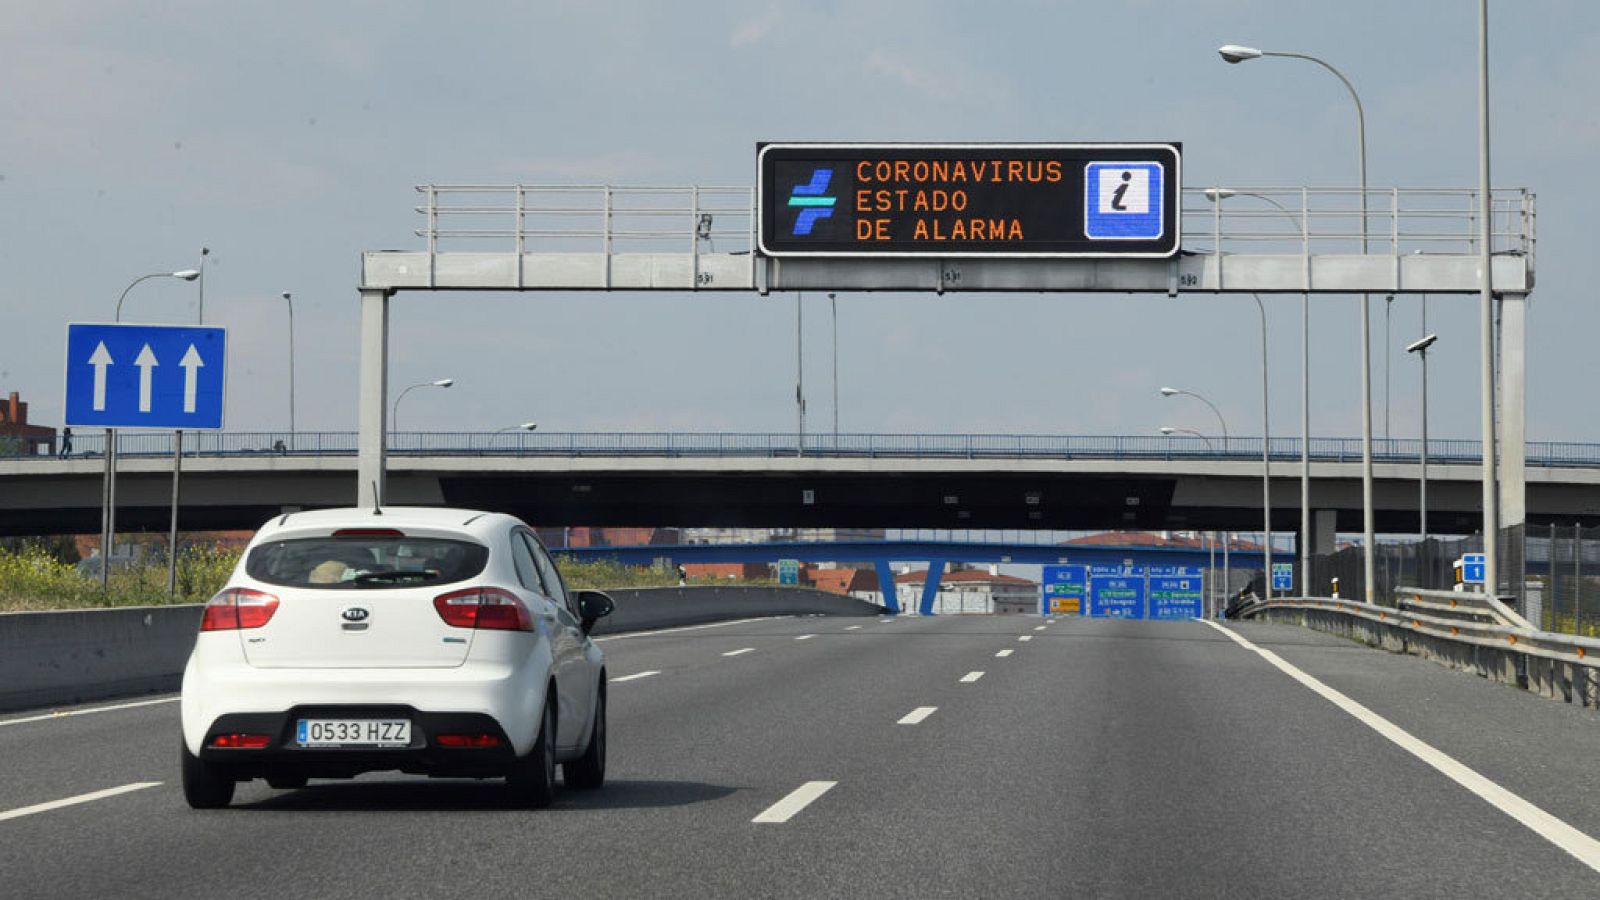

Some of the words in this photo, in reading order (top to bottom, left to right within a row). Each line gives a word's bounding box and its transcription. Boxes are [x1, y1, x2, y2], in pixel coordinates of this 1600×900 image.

[857, 160, 1062, 183] CORONAVIRUS
[857, 189, 968, 212] ESTADO
[857, 218, 891, 241] DE
[914, 218, 1024, 241] ALARMA
[310, 722, 361, 740] 0533
[367, 722, 406, 740] HZZ
